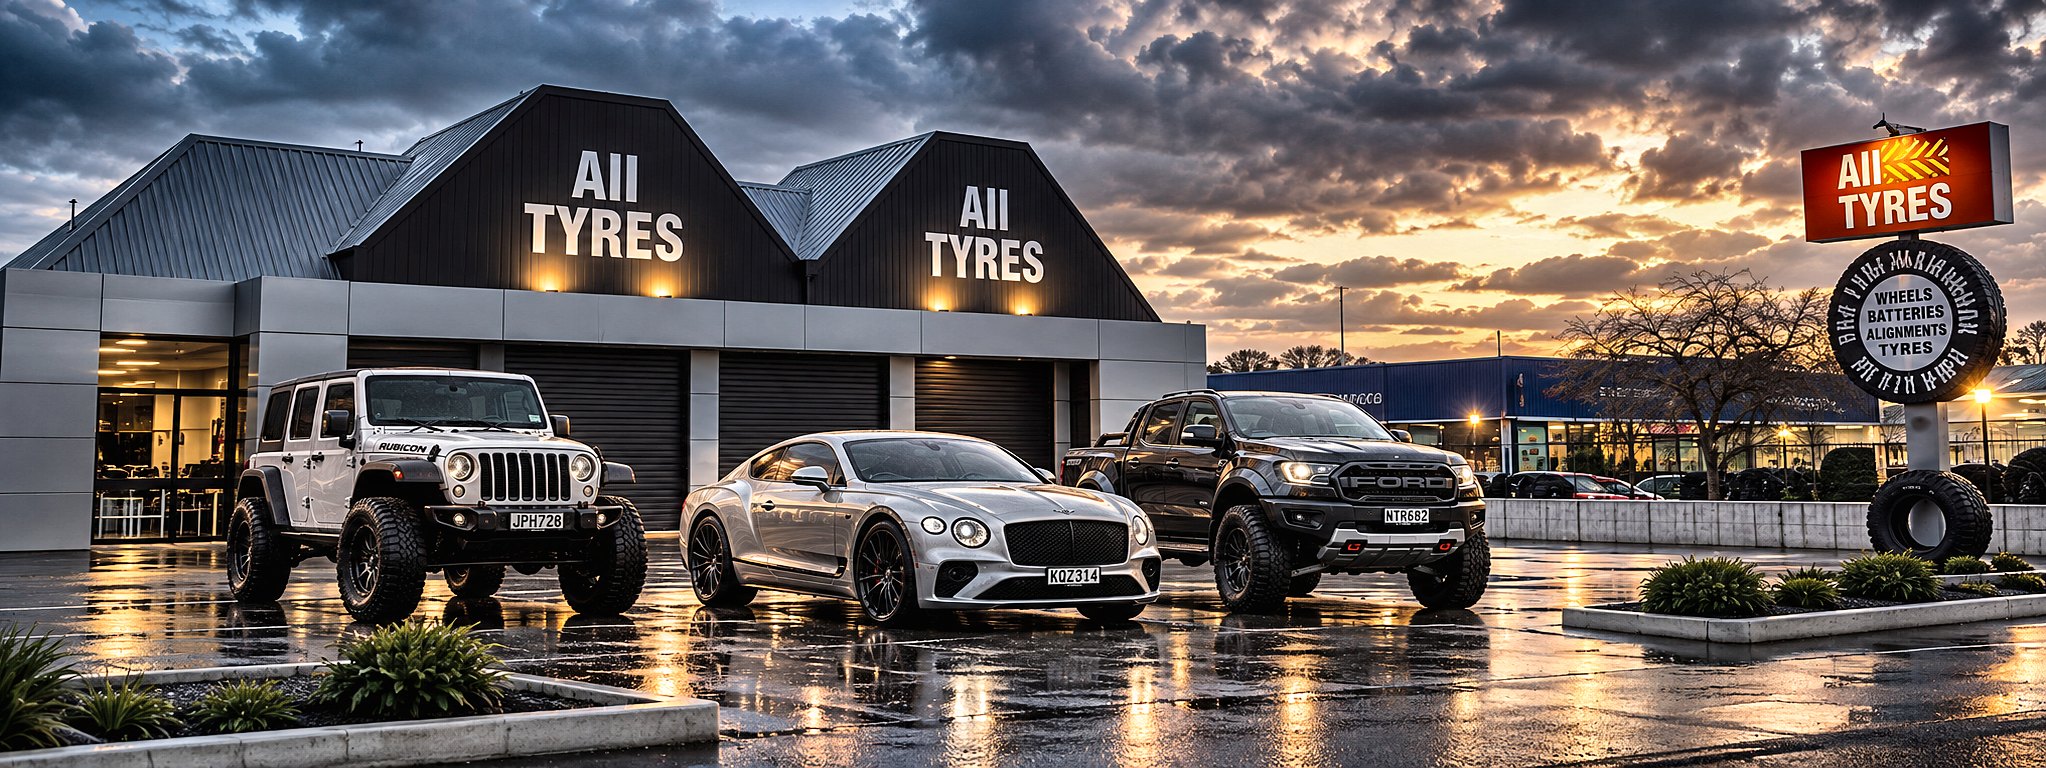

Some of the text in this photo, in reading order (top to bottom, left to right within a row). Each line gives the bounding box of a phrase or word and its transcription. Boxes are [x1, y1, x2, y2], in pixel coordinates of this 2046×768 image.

[571, 150, 638, 203] All
[1838, 149, 1882, 189] All
[959, 185, 1009, 231] All
[1838, 182, 1952, 229] TYRES
[524, 202, 684, 262] TYRES
[925, 231, 1044, 283] TYRES
[1875, 287, 1933, 305] WHEELS
[1867, 304, 1945, 323] BATTERIES
[1866, 323, 1948, 341] ALIGNMENTS
[1878, 341, 1933, 356] TYRES
[378, 442, 427, 453] RUBICON
[1350, 476, 1446, 488] FORD
[512, 514, 562, 528] JPH728
[1386, 510, 1428, 522] NTR682
[1050, 568, 1098, 583] KQZ314
